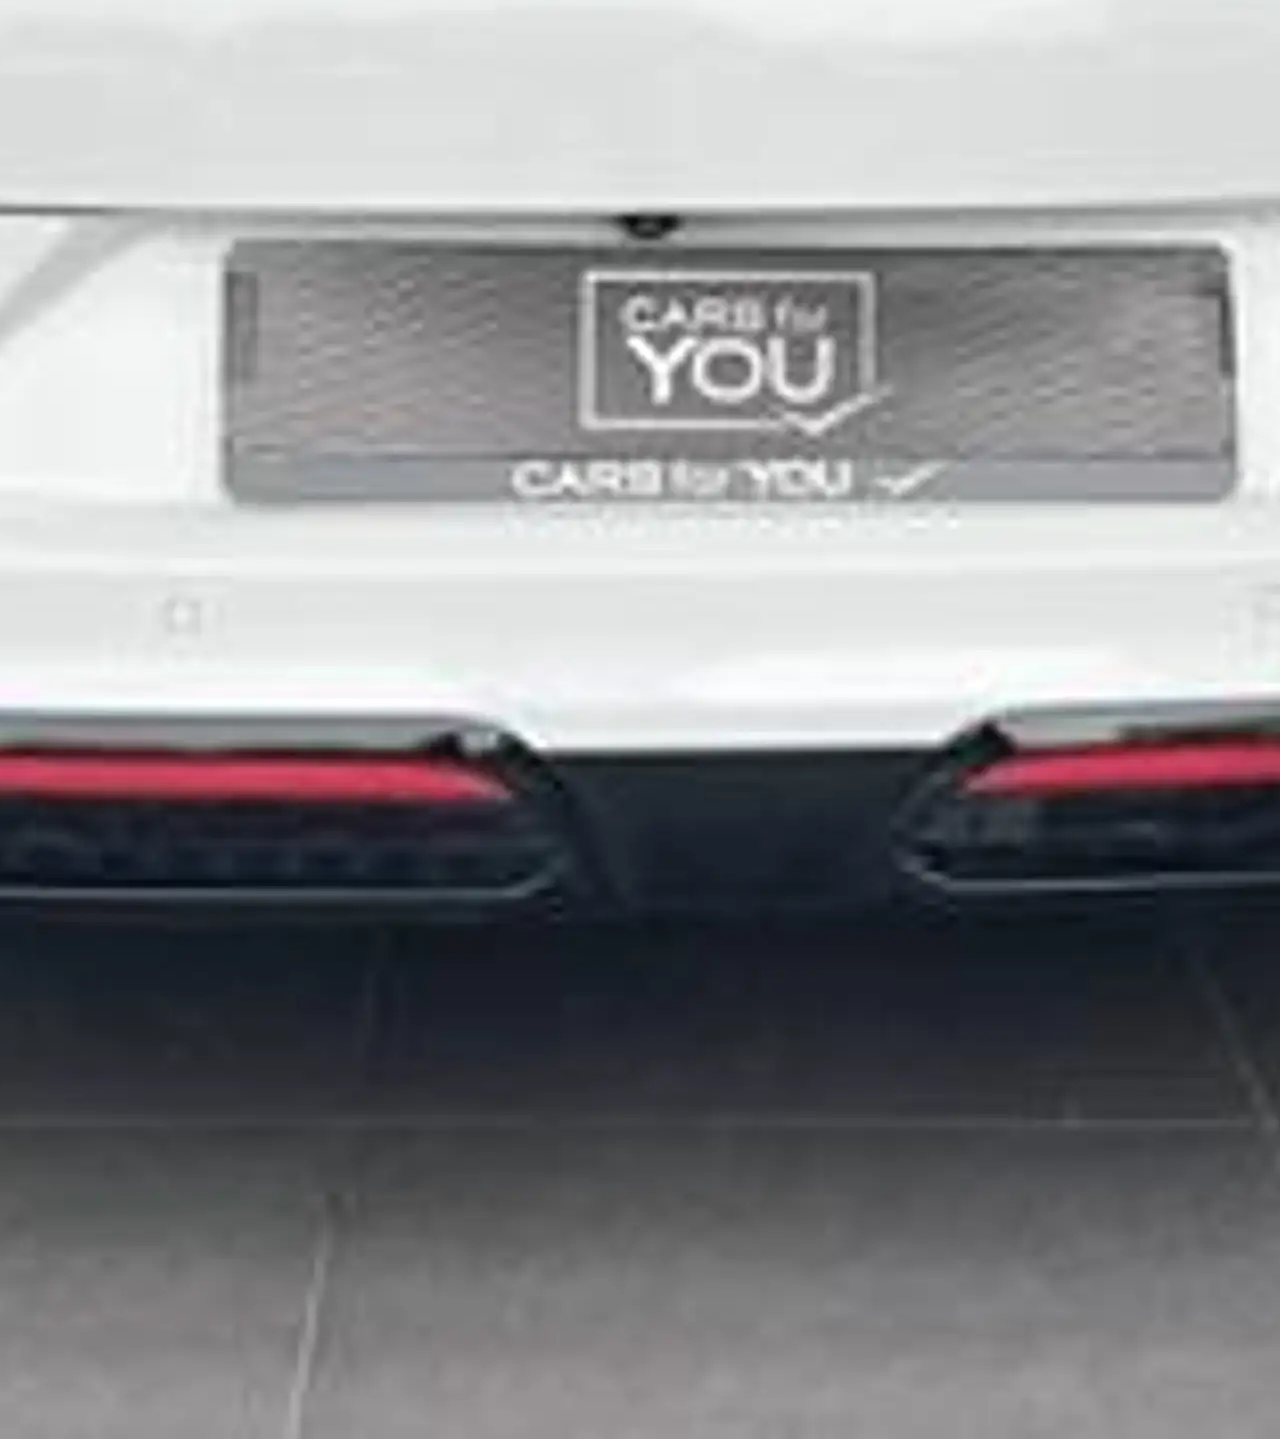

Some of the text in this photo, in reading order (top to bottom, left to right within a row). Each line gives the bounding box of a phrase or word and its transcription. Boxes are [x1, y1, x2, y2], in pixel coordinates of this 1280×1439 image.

[622, 294, 766, 333] CARS
[626, 335, 835, 406] YOU
[511, 458, 664, 498] CARS
[734, 457, 854, 502] YOU
